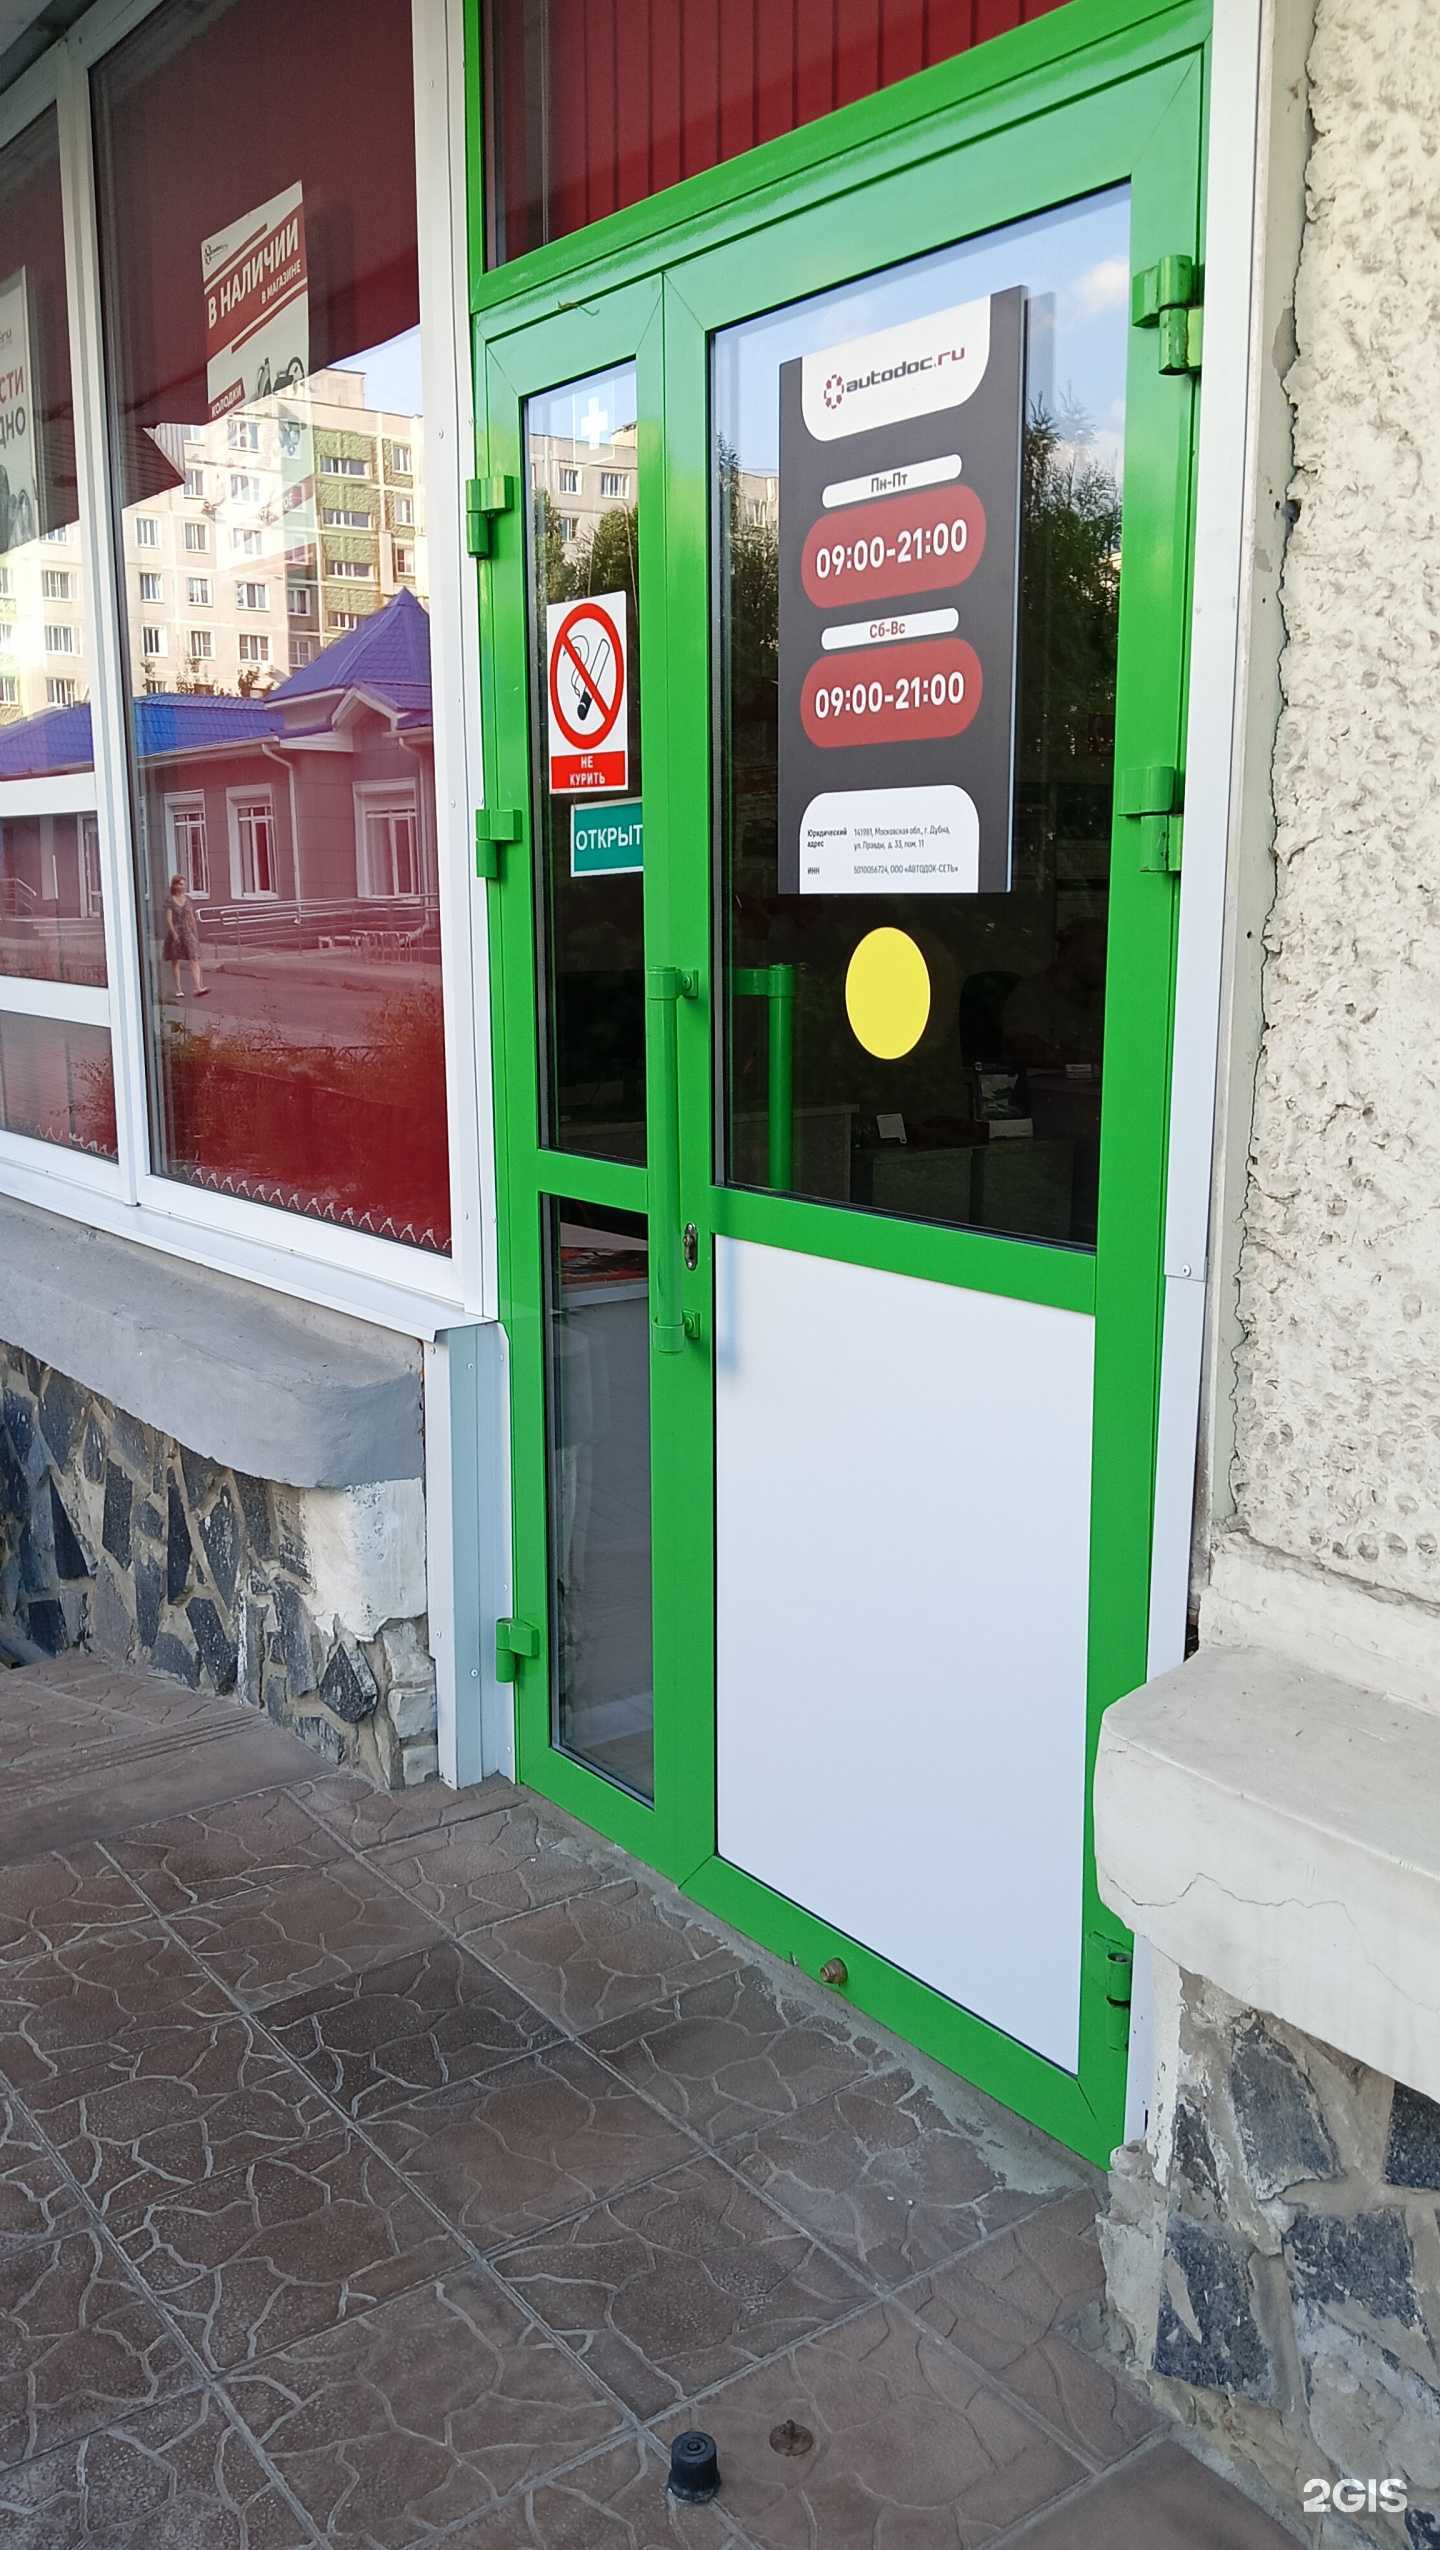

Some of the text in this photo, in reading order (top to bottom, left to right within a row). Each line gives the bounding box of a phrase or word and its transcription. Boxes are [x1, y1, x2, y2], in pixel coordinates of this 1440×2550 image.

[208, 217, 298, 329] В НАЛИЧИИ
[261, 259, 301, 304] В МАГАЗИНЕ
[846, 347, 965, 393] autodoc.ru
[870, 471, 909, 493] Пн-Пт
[816, 519, 968, 579] 09:00-21:00
[869, 620, 906, 639] Сб-Вс
[815, 671, 965, 719] 09:00-21:00
[580, 755, 594, 769] НЕ
[569, 772, 606, 786] КУРИТЬ
[807, 827, 848, 839] Юридический
[874, 827, 909, 836] Московская
[807, 840, 824, 849] адрес
